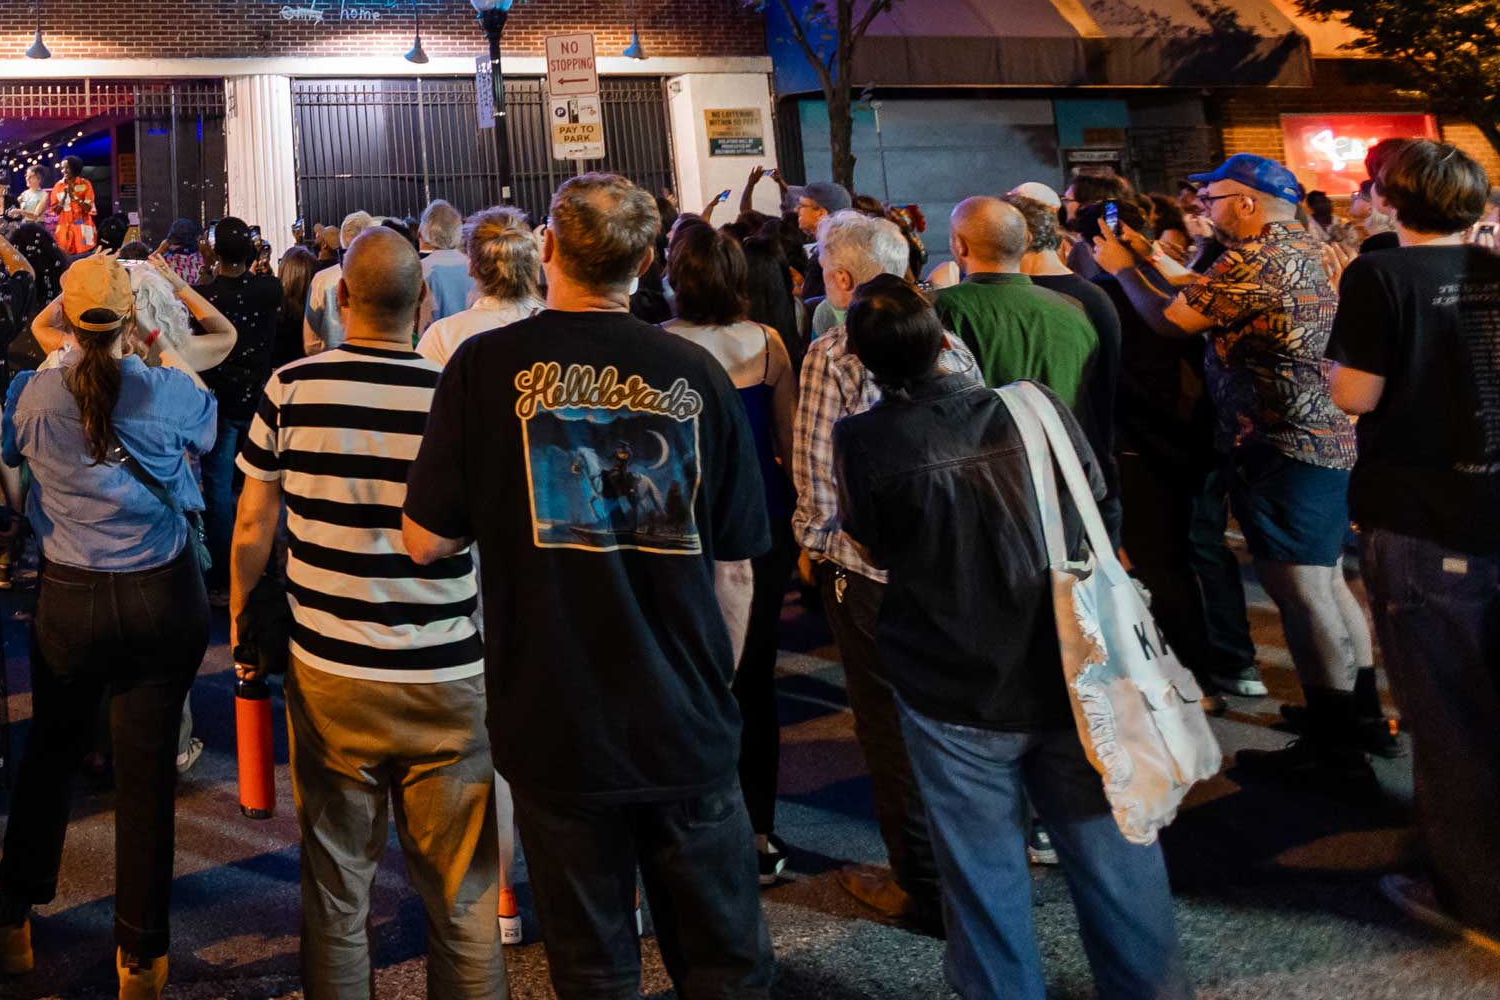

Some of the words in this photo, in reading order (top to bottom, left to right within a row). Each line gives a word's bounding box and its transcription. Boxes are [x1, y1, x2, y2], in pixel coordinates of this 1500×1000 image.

[560, 41, 579, 54] NO
[550, 57, 593, 72] STOPPING
[559, 125, 578, 135] PAY
[581, 124, 594, 134] TO
[564, 133, 590, 143] PARK
[515, 362, 703, 422] Helldorado
